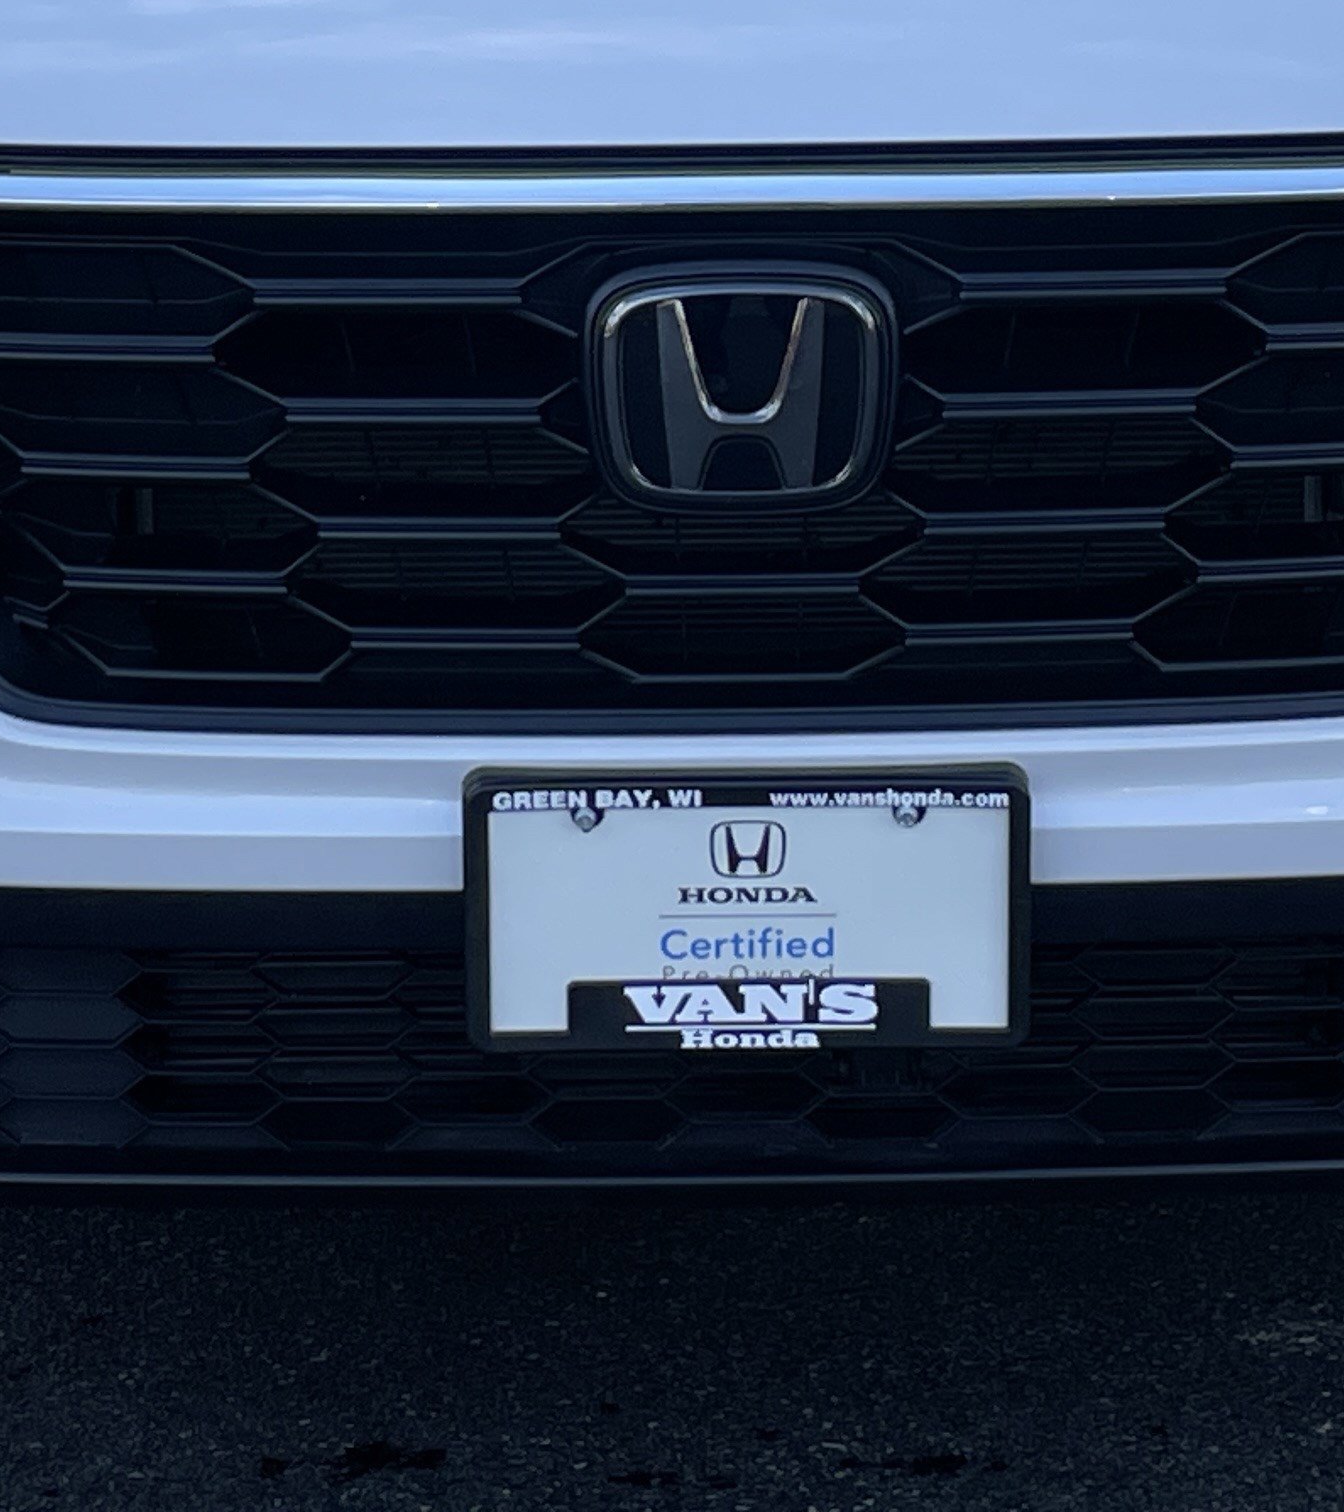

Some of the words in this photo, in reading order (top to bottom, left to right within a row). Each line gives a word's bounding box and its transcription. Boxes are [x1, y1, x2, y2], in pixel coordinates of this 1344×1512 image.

[491, 790, 589, 811] GREEN
[594, 789, 661, 810] BAY,
[666, 789, 703, 808] WI
[768, 787, 1010, 808] www.vanshonda.com
[678, 886, 819, 905] HONDA
[660, 926, 835, 960] Certified
[622, 978, 879, 1024] VAN'S
[679, 1028, 822, 1050] Honda
